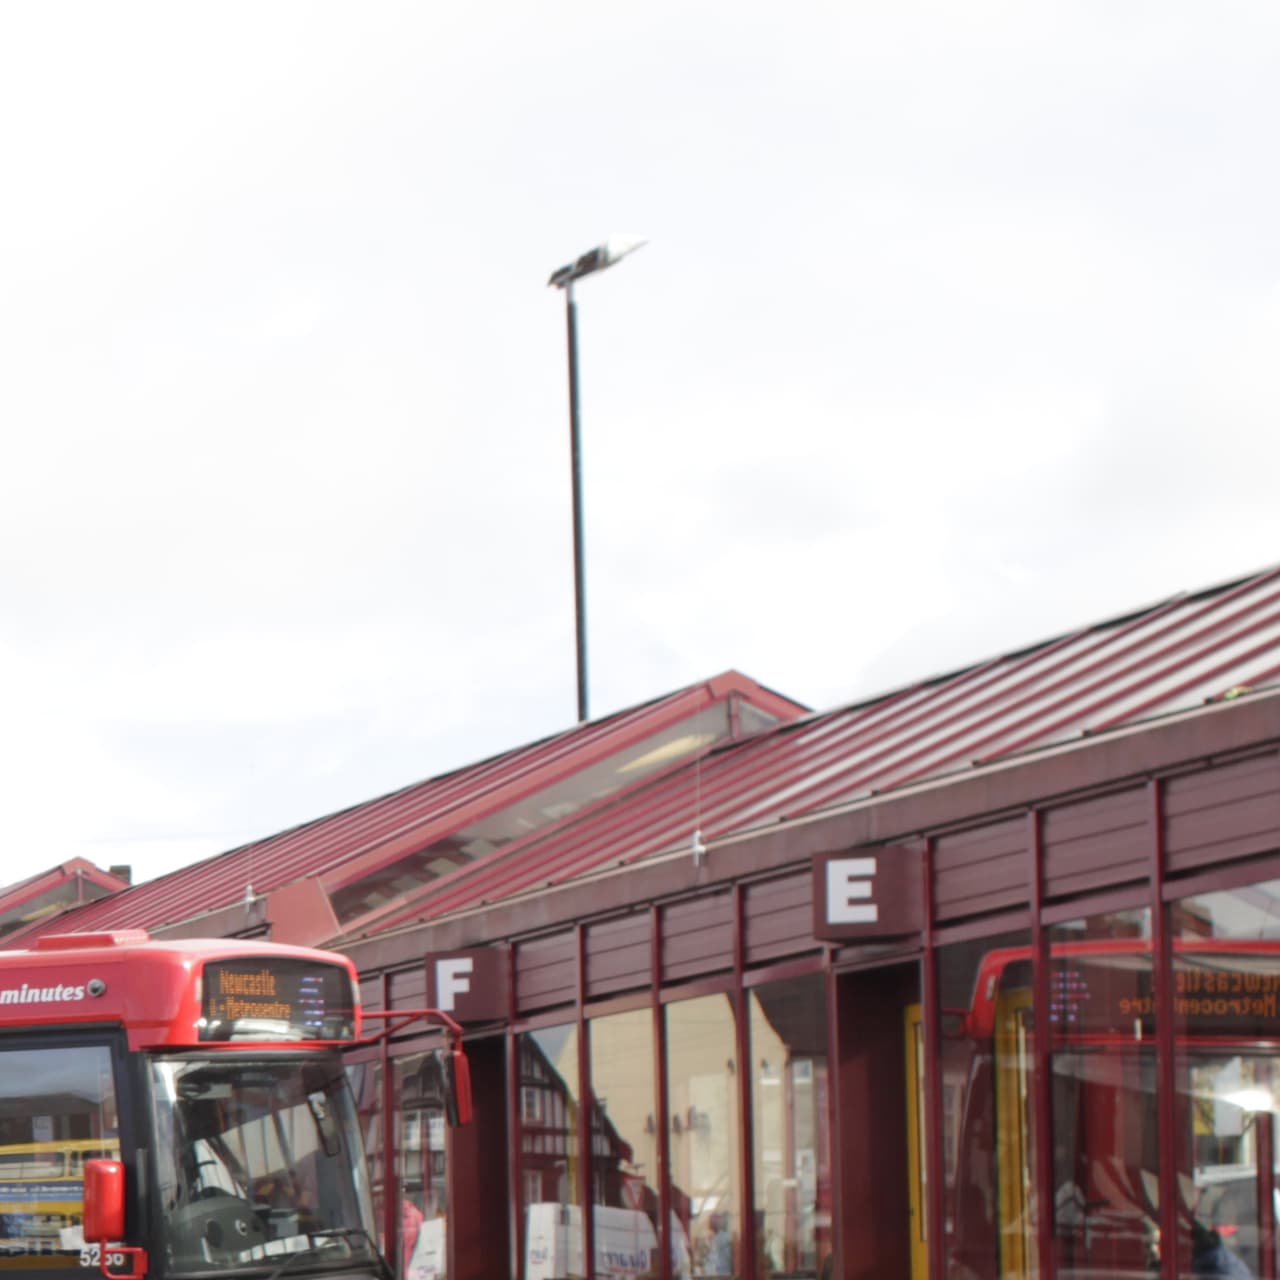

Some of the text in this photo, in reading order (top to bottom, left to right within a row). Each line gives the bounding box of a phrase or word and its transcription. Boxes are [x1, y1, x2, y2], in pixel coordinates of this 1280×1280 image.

[826, 857, 878, 925] E
[220, 968, 276, 996] Newcastle
[435, 957, 473, 1011] F
